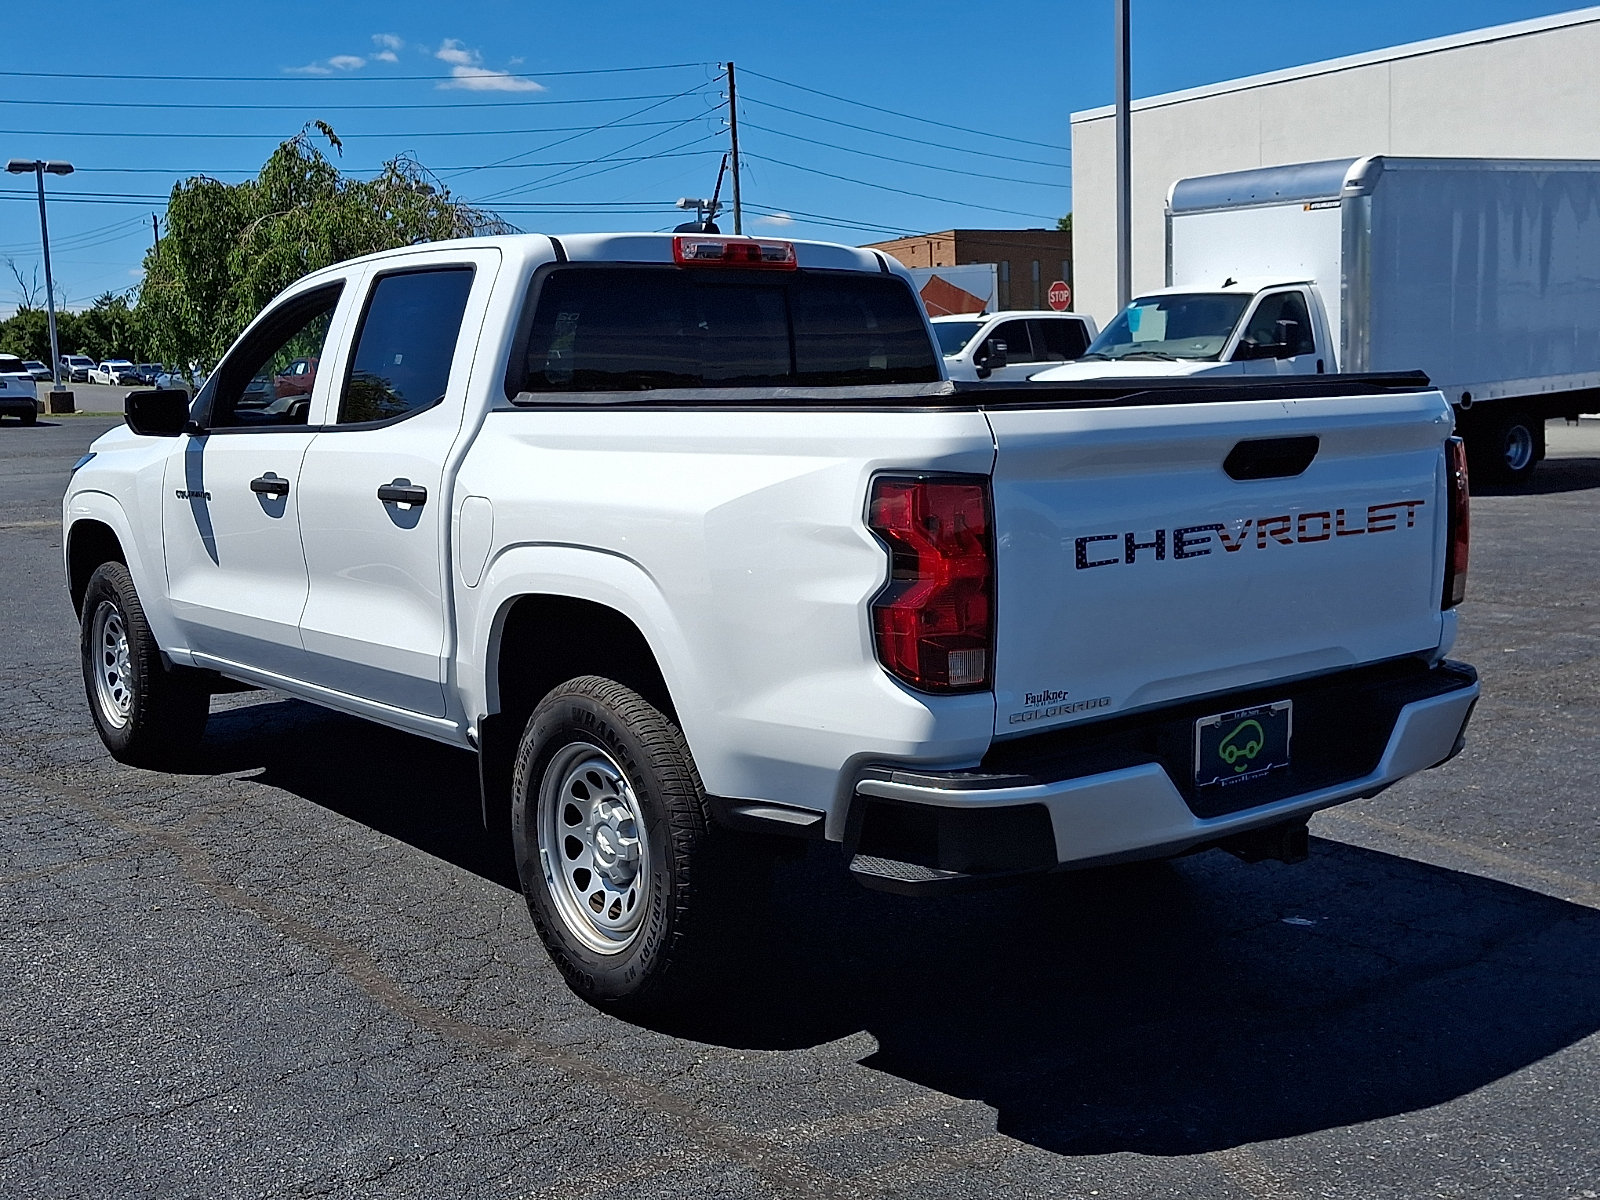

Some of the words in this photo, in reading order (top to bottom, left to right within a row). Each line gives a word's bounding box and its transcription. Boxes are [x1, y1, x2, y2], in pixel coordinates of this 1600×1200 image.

[1050, 290, 1069, 303] STOP
[1075, 500, 1425, 570] CHEVROLET
[1009, 696, 1113, 725] COLORADO
[1024, 689, 1069, 705] Faulkner
[572, 706, 651, 804] WRANGLER
[639, 871, 662, 967] TERRITORY
